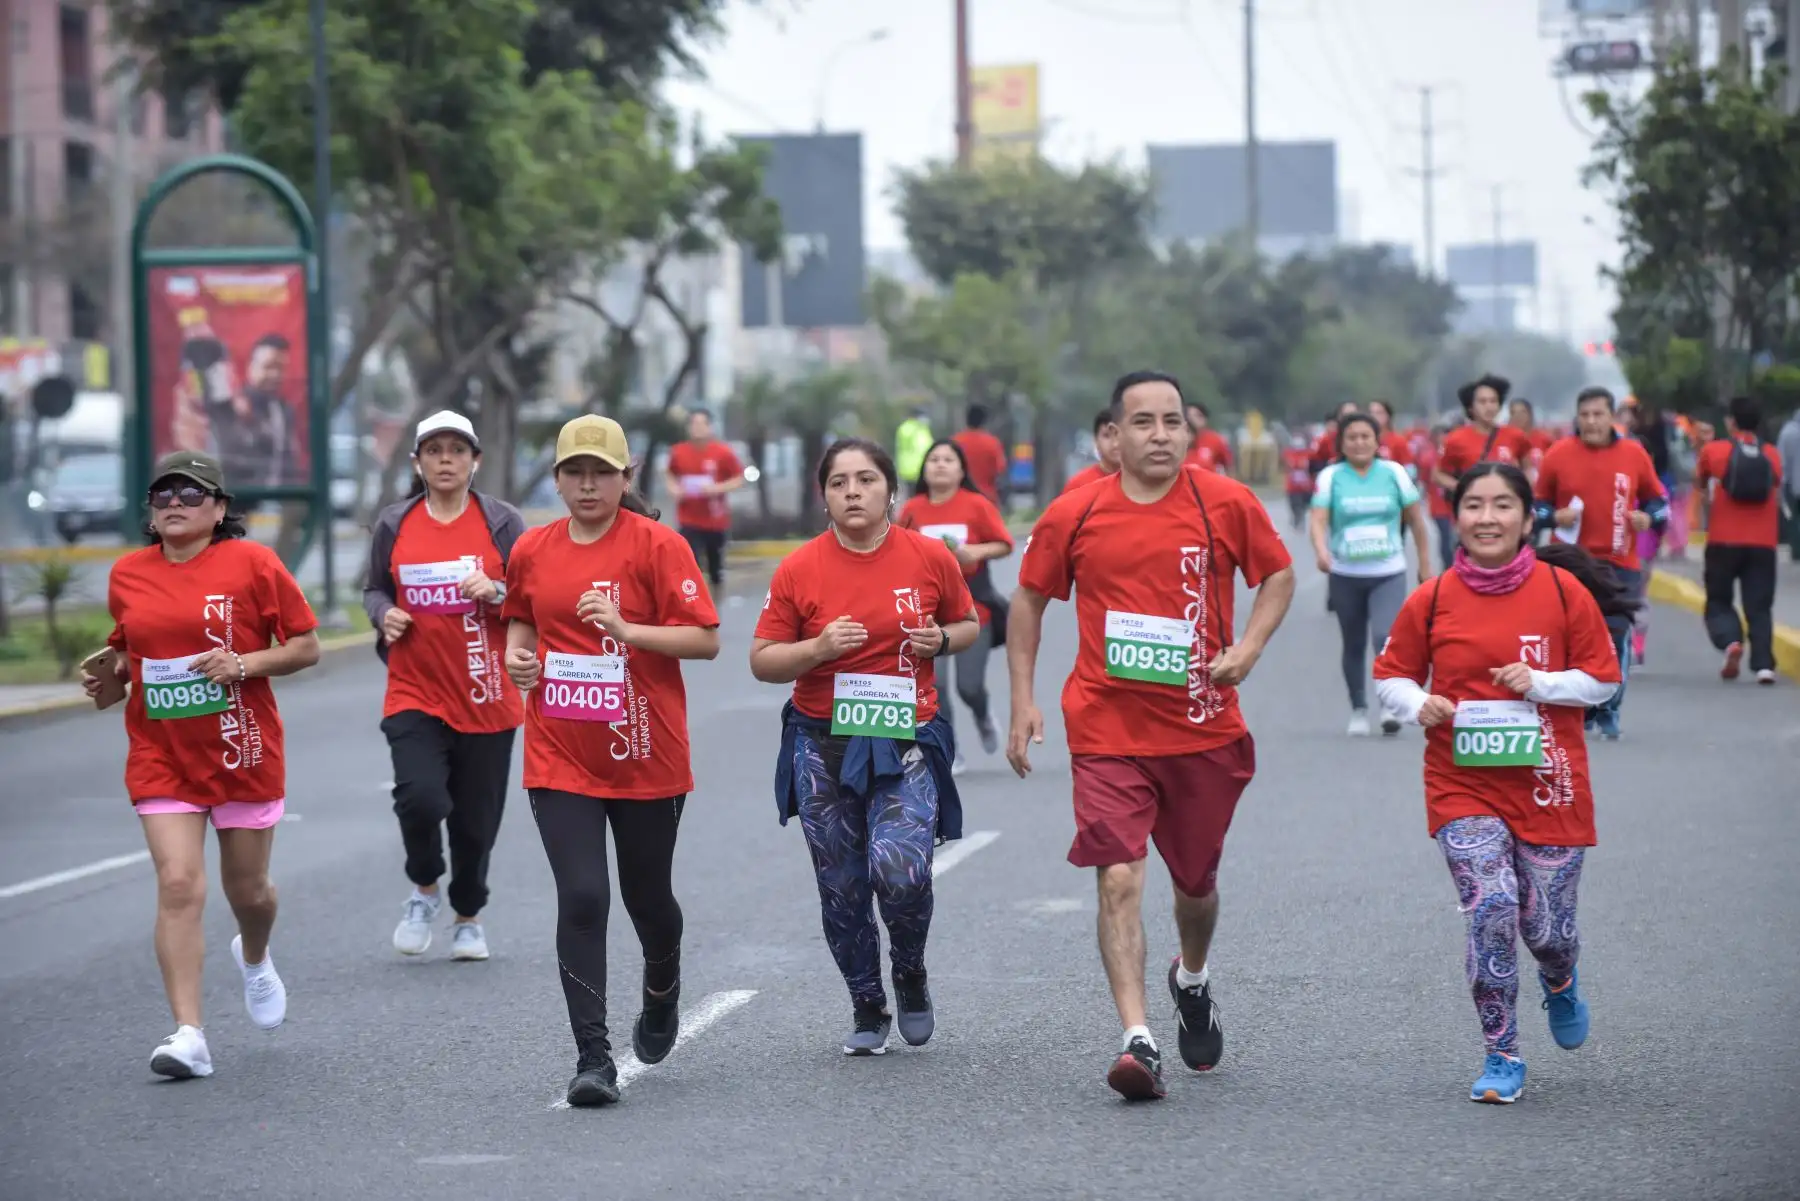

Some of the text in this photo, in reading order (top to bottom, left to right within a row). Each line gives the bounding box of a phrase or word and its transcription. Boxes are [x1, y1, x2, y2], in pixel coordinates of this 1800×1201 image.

[226, 596, 234, 624] SOCIAL
[893, 587, 915, 614] 21
[913, 588, 922, 614] SOCIAL
[1124, 630, 1161, 640] CARRERA
[1180, 546, 1206, 724] CABILOS 21
[1520, 635, 1541, 663] 21
[463, 611, 489, 704] CABILD
[1108, 642, 1187, 673] 00935
[156, 673, 191, 681] CARRERA
[204, 594, 241, 769] CABILS 21
[557, 670, 591, 679] CARRERA
[147, 681, 223, 709] 00989
[545, 682, 620, 710] 00405
[623, 667, 637, 724] BICENTENARIO
[853, 690, 889, 698] CARRERA
[637, 696, 651, 759] HUANCAYO
[836, 702, 913, 729] 00793
[243, 734, 251, 768] FESTIVAL
[245, 708, 263, 766] TRUJILLO
[631, 726, 639, 760] FESTIVAL
[1456, 731, 1538, 755] 00977
[1557, 747, 1574, 806] HUANCAYO
